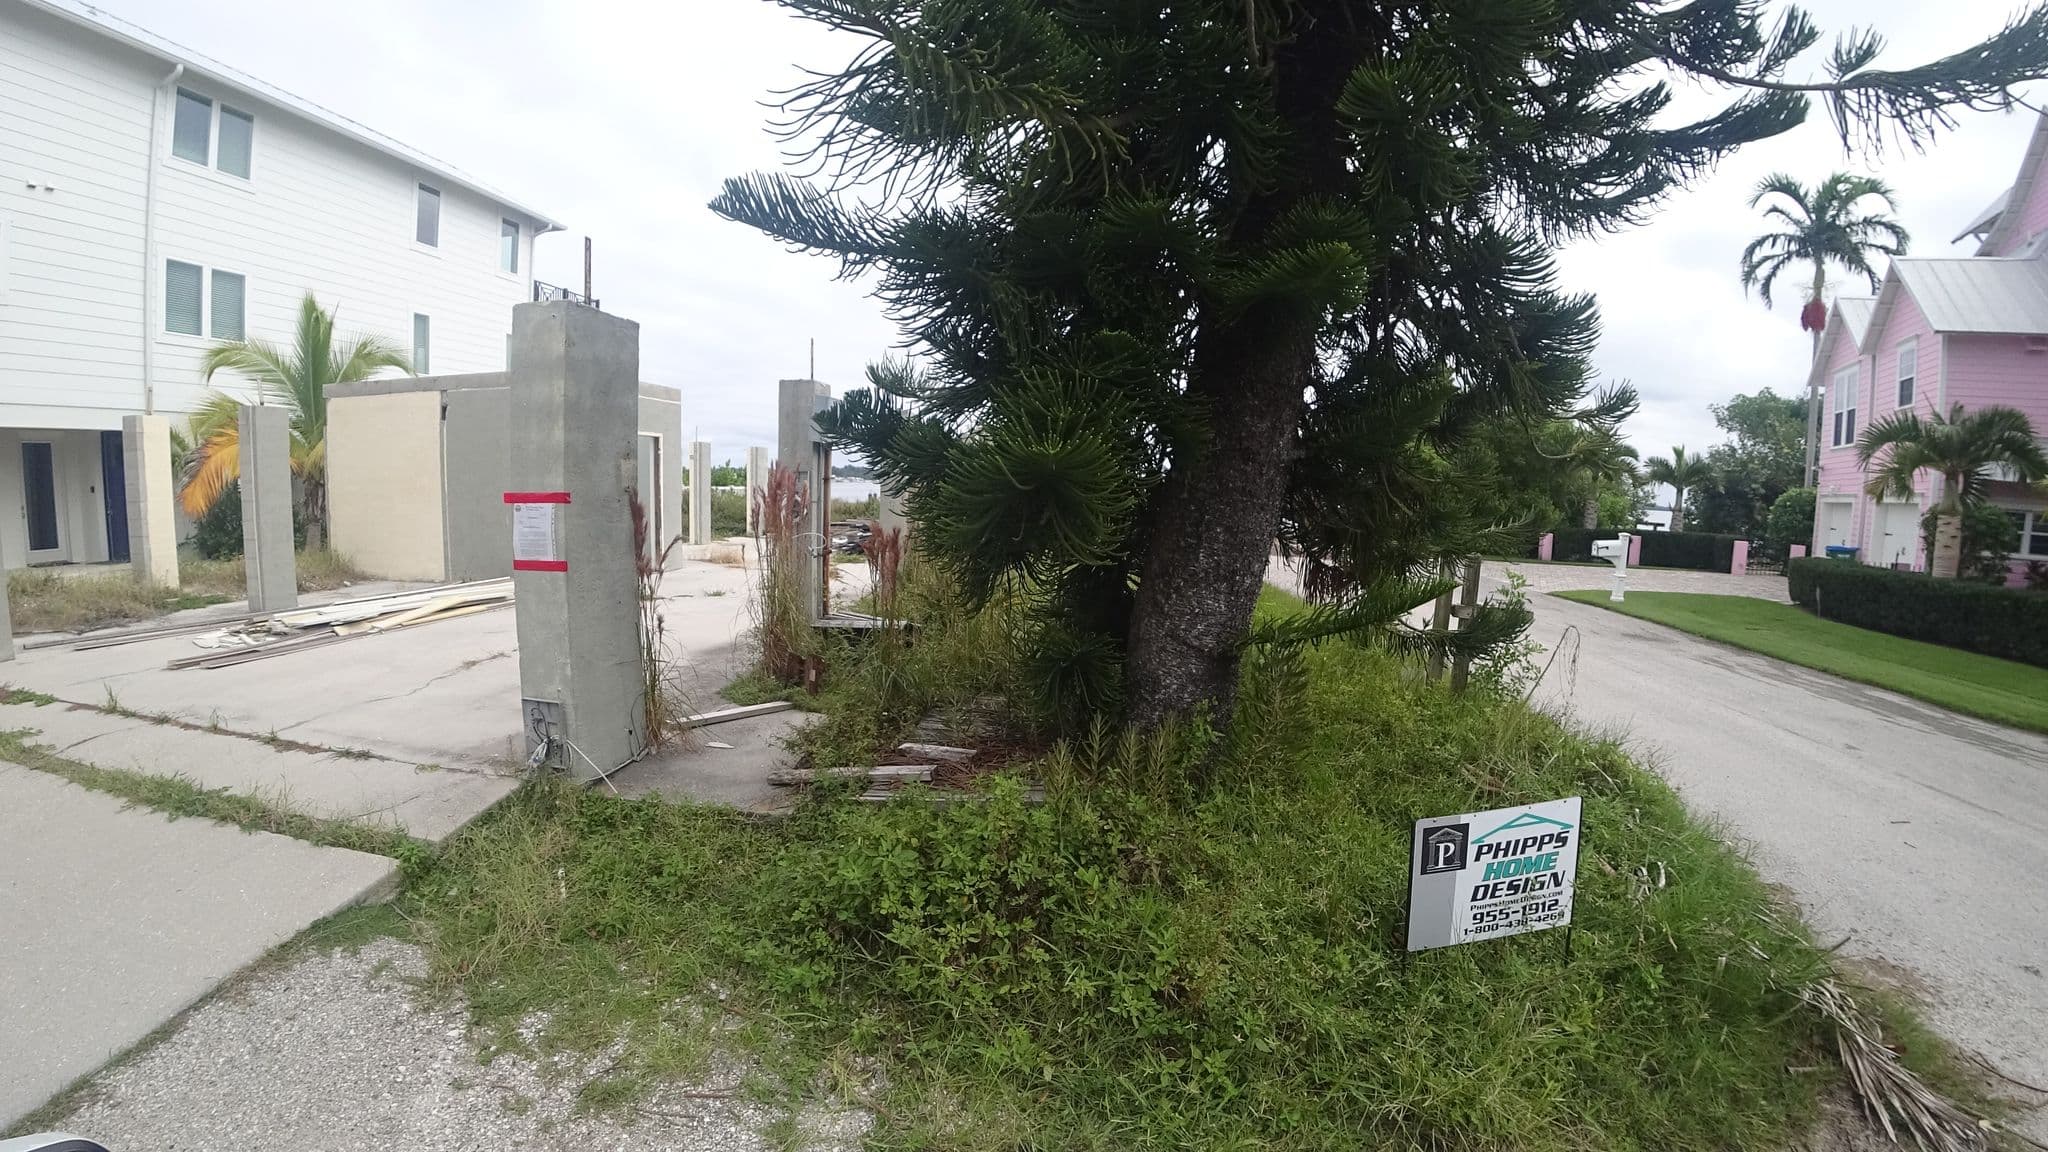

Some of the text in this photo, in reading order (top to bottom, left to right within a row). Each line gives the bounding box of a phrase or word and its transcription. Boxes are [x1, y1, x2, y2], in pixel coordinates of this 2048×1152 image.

[1436, 842, 1456, 868] P
[1474, 831, 1570, 862] PHIPPS
[1482, 851, 1560, 881] HOME
[1470, 870, 1566, 902] DESIGN
[1472, 899, 1559, 925] 955-1912
